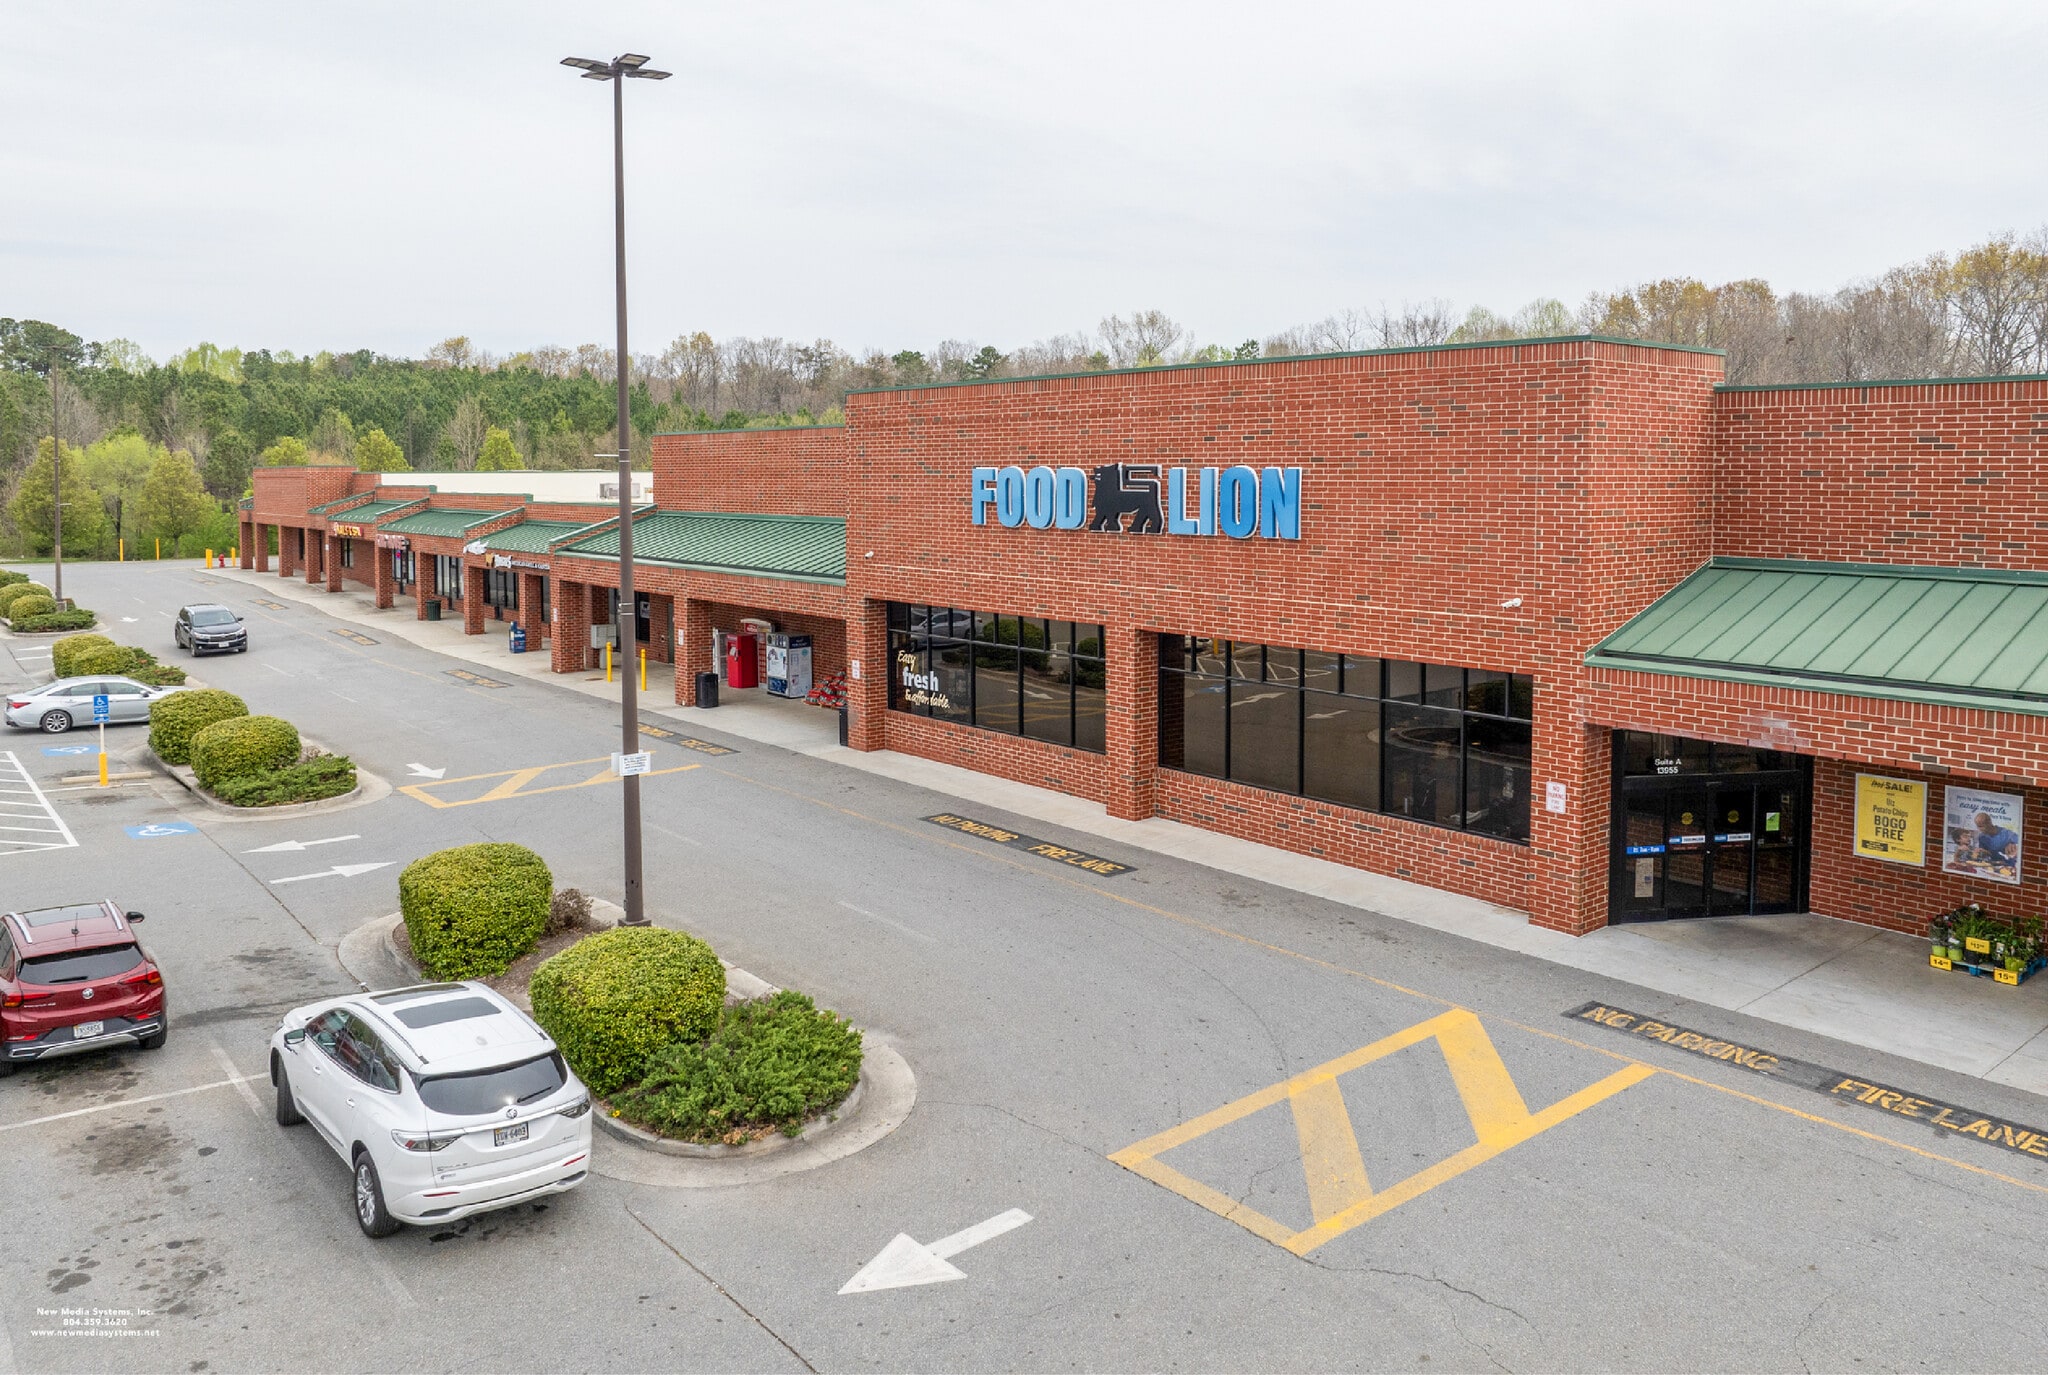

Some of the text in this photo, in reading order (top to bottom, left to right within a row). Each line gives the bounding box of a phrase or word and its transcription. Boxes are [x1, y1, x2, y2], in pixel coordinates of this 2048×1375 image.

[972, 465, 1303, 539] FOOD LION
[897, 650, 916, 671] Easy
[902, 666, 939, 692] fresh
[1654, 758, 1674, 766] Suite
[1885, 781, 1913, 793] SALE!
[1873, 804, 1909, 818] Potato Chips
[1959, 802, 1979, 813] easy
[1874, 815, 1906, 830] BOGO
[1875, 826, 1904, 841] FREE
[955, 820, 1018, 842] PARKING
[1028, 844, 1077, 859] FIRE
[1067, 855, 1126, 874] LANE
[1581, 1006, 2048, 1156] NO PARKING FIRE LANE
